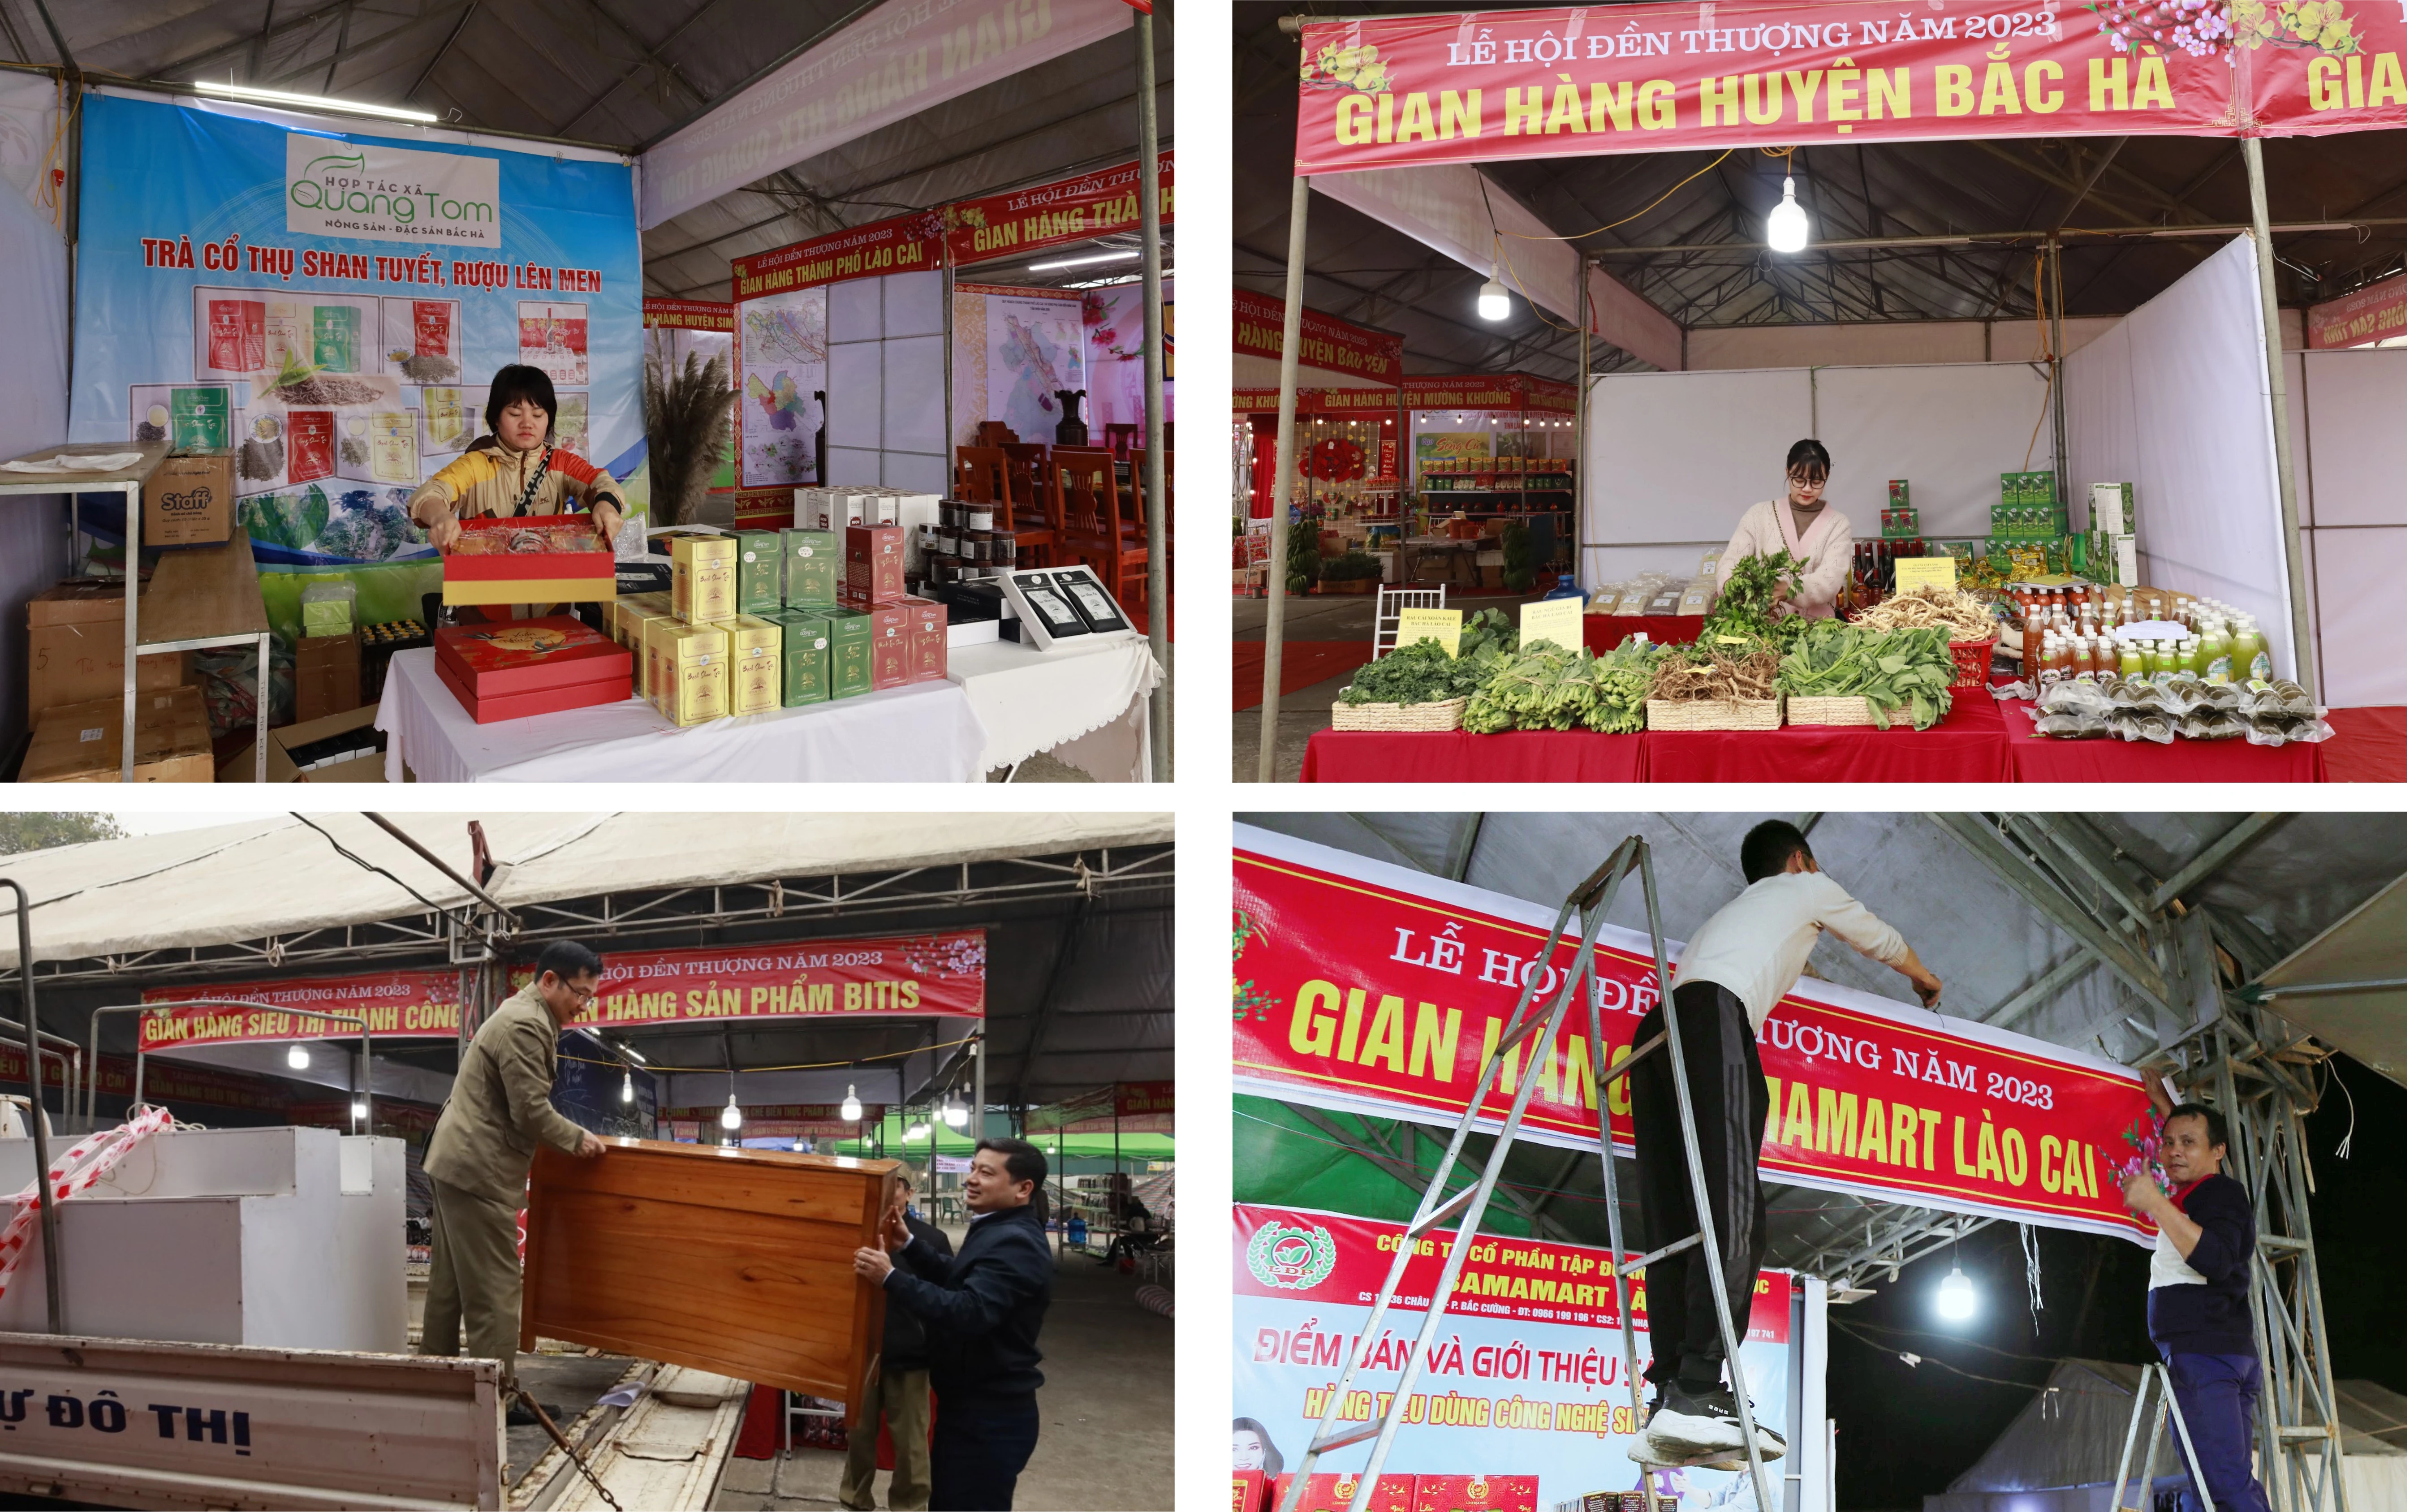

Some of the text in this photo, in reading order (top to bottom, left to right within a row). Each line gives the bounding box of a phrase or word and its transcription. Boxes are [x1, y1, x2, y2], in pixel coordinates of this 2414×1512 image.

[1447, 12, 2056, 67] LỄ HỘI ĐỀN THƯỢNG NĂM 2023
[1336, 42, 2175, 145] GIAN HÀNG HUYỆN BẮC HÀ
[290, 180, 492, 223] Quang Tom
[325, 176, 422, 195] HỢP TÁC XÃ
[1008, 176, 1103, 211] LỄ HỘI ĐỀN
[325, 220, 484, 238] NÔNG SẢN ĐẶC SẢN BẮC HÀ
[974, 187, 1174, 252] GIAN HÀNG THÀH
[142, 234, 601, 293] TRÀ CỔ THỤ SHAN TUYẾT, RƯỢU LÊN MEN
[741, 241, 922, 295] GIAN HÀNG THÀNH PHỐ LÀO CAI
[758, 228, 892, 269] LỄ HỘI ĐỀN THƯỢNG NĂM 2023
[652, 302, 729, 314] HỘI ĐỀN THƯỢNG NĂM
[657, 313, 682, 326] HÀNG
[685, 314, 715, 329] HUYỆN
[1237, 321, 1283, 353] HÀNG
[1350, 332, 1367, 346] 2023
[1325, 394, 1350, 407] GIAN
[1354, 392, 1382, 406] HÀNG
[1424, 391, 1464, 405] MƯỜNG
[1466, 391, 1511, 405] KHƯƠNG
[161, 491, 209, 511] Staff
[37, 648, 51, 670] 5
[598, 950, 883, 982] HỘI ĐỀN THƯỢNG NĂM 2023
[272, 988, 333, 1004] THƯỢNG
[336, 984, 372, 999] NĂM
[375, 984, 410, 997] 2023
[607, 989, 677, 1021] HÀNG
[685, 982, 741, 1017] SẢN
[751, 973, 834, 1014] PHẨM
[844, 980, 920, 1010] BITIS
[146, 1017, 188, 1041] GIAN
[194, 1012, 242, 1039] HÀNG
[332, 1003, 398, 1032] THÀNH
[405, 998, 460, 1030] CÔNG
[1390, 921, 1465, 975] LỄ
[1892, 1047, 1978, 1093] NĂM
[1987, 1073, 2053, 1111] 2023
[1289, 979, 1462, 1083] GIAN
[1954, 1109, 2026, 1187] LÀO
[2040, 1135, 2099, 1199] CAI
[1470, 1241, 1498, 1263] CỔ
[1501, 1247, 1554, 1271] PHẦN
[1559, 1254, 1595, 1277] TẬP
[1358, 1292, 1372, 1301] CS
[1404, 1296, 1430, 1307] CHÂU
[1461, 1300, 1479, 1312] BẮC
[1481, 1303, 1511, 1315] CƯỜNG
[1518, 1307, 1531, 1316] ĐT:
[1532, 1308, 1554, 1318] 0966
[1556, 1310, 1571, 1320] 199
[1573, 1311, 1589, 1321] 196
[1596, 1314, 1614, 1325] CS2:
[1761, 1330, 1775, 1339] 741
[1254, 1318, 1342, 1367] ĐIỂM
[1427, 1335, 1465, 1376] VÀ
[1472, 1340, 1531, 1380] GIỚI
[1538, 1347, 1617, 1391] THIỆU
[46, 1390, 250, 1456] ĐÔ THỊ
[1431, 1391, 1609, 1438] DÙNG CÔNG NGHỆ
